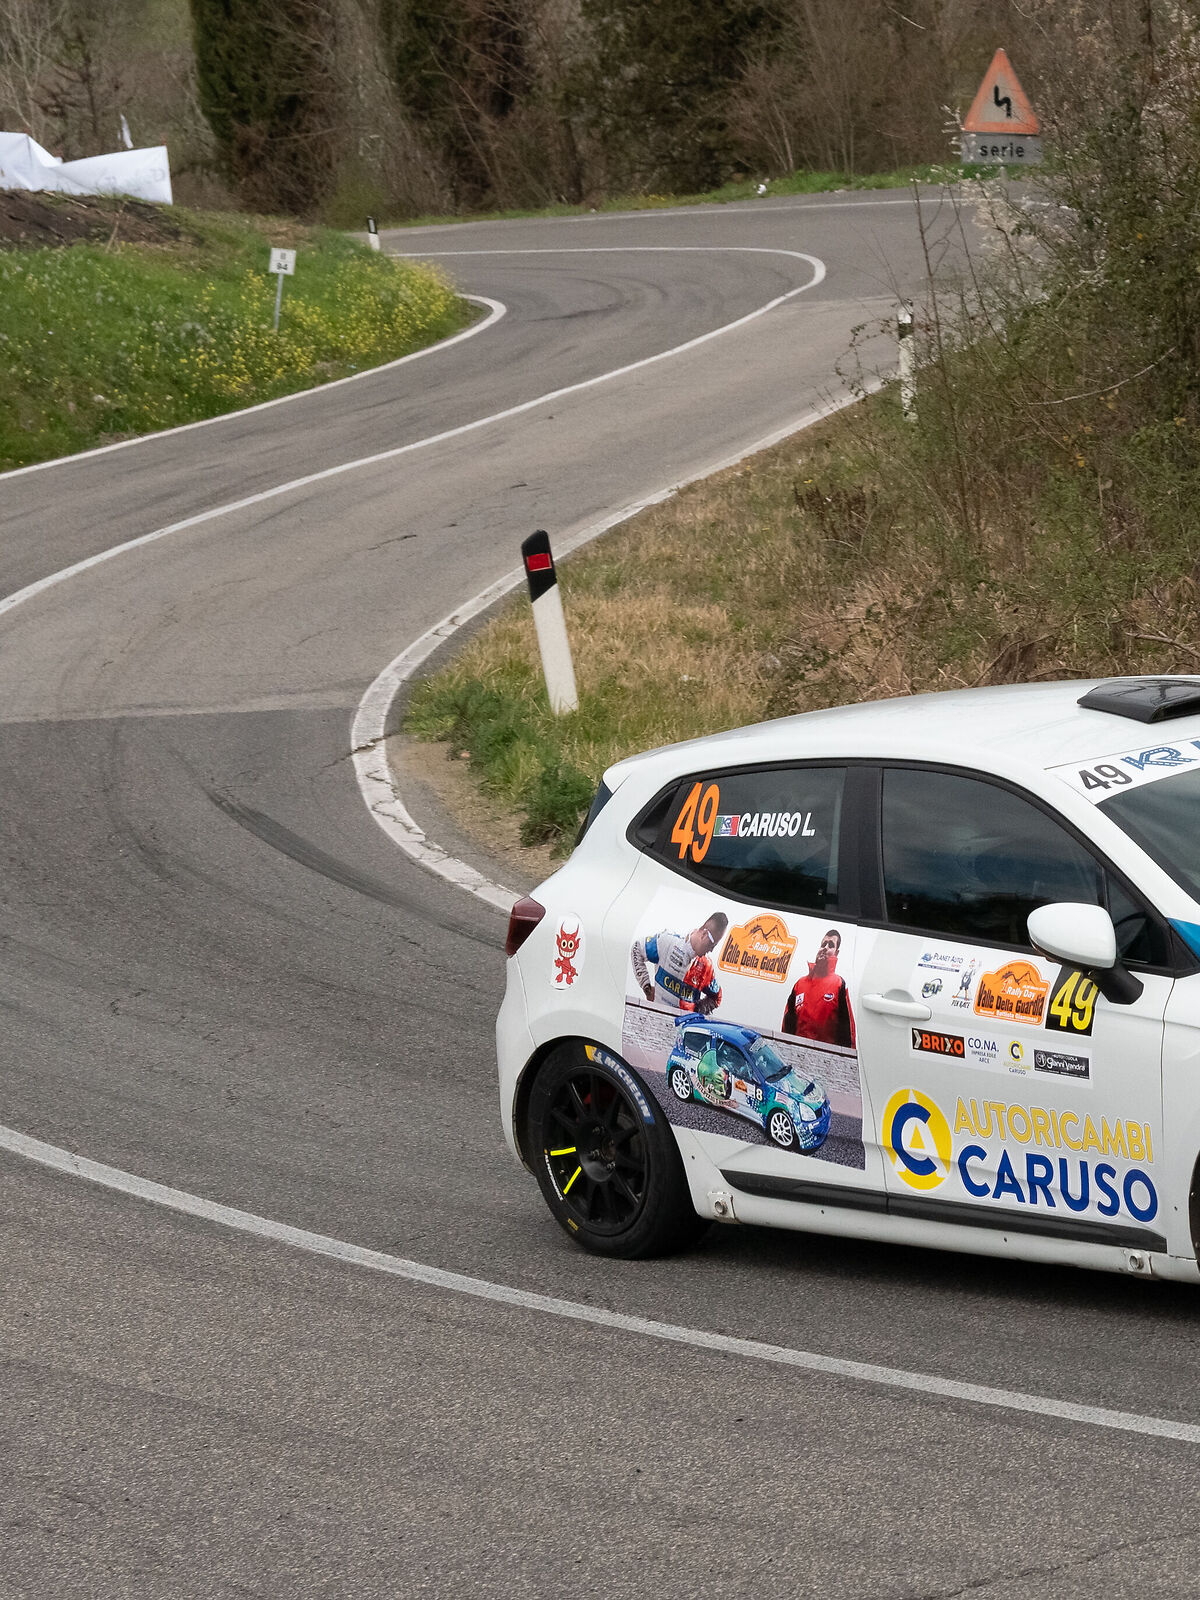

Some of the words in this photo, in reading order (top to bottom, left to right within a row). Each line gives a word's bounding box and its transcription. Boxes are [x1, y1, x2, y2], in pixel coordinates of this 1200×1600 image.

[979, 142, 1025, 158] serie
[1078, 764, 1133, 791] 49
[670, 782, 720, 863] 49
[739, 812, 802, 838] CARUSO
[802, 812, 816, 837] L.
[721, 933, 741, 964] Valle
[740, 951, 760, 969] Della
[977, 979, 995, 1009] Valle
[996, 995, 1014, 1012] Della
[1015, 993, 1045, 1016] Guardia
[1006, 986, 1024, 999] Rally
[1023, 988, 1037, 1000] Day
[1050, 971, 1099, 1031] 49
[922, 1033, 964, 1056] BRIXO
[968, 1037, 1000, 1053] CO.NA.
[604, 1056, 651, 1117] MICHELIN
[953, 1096, 1154, 1163] AUTORICAMBI
[957, 1144, 1159, 1223] CARUSO
